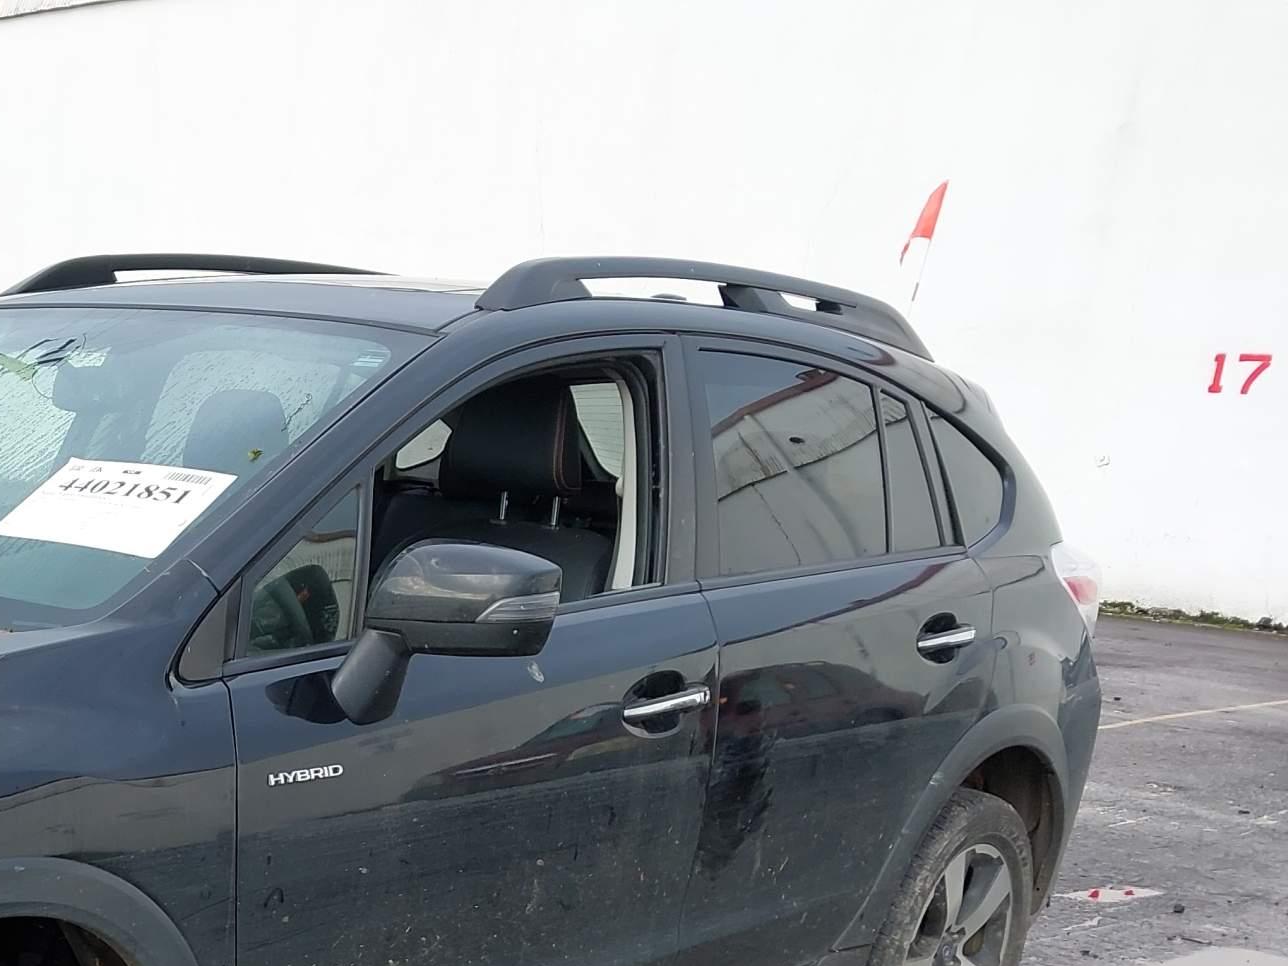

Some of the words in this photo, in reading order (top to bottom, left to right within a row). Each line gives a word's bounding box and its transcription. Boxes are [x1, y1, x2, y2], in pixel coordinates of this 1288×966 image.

[1207, 352, 1273, 396] 17
[59, 478, 191, 504] 44021851
[268, 764, 344, 786] HYBRID
